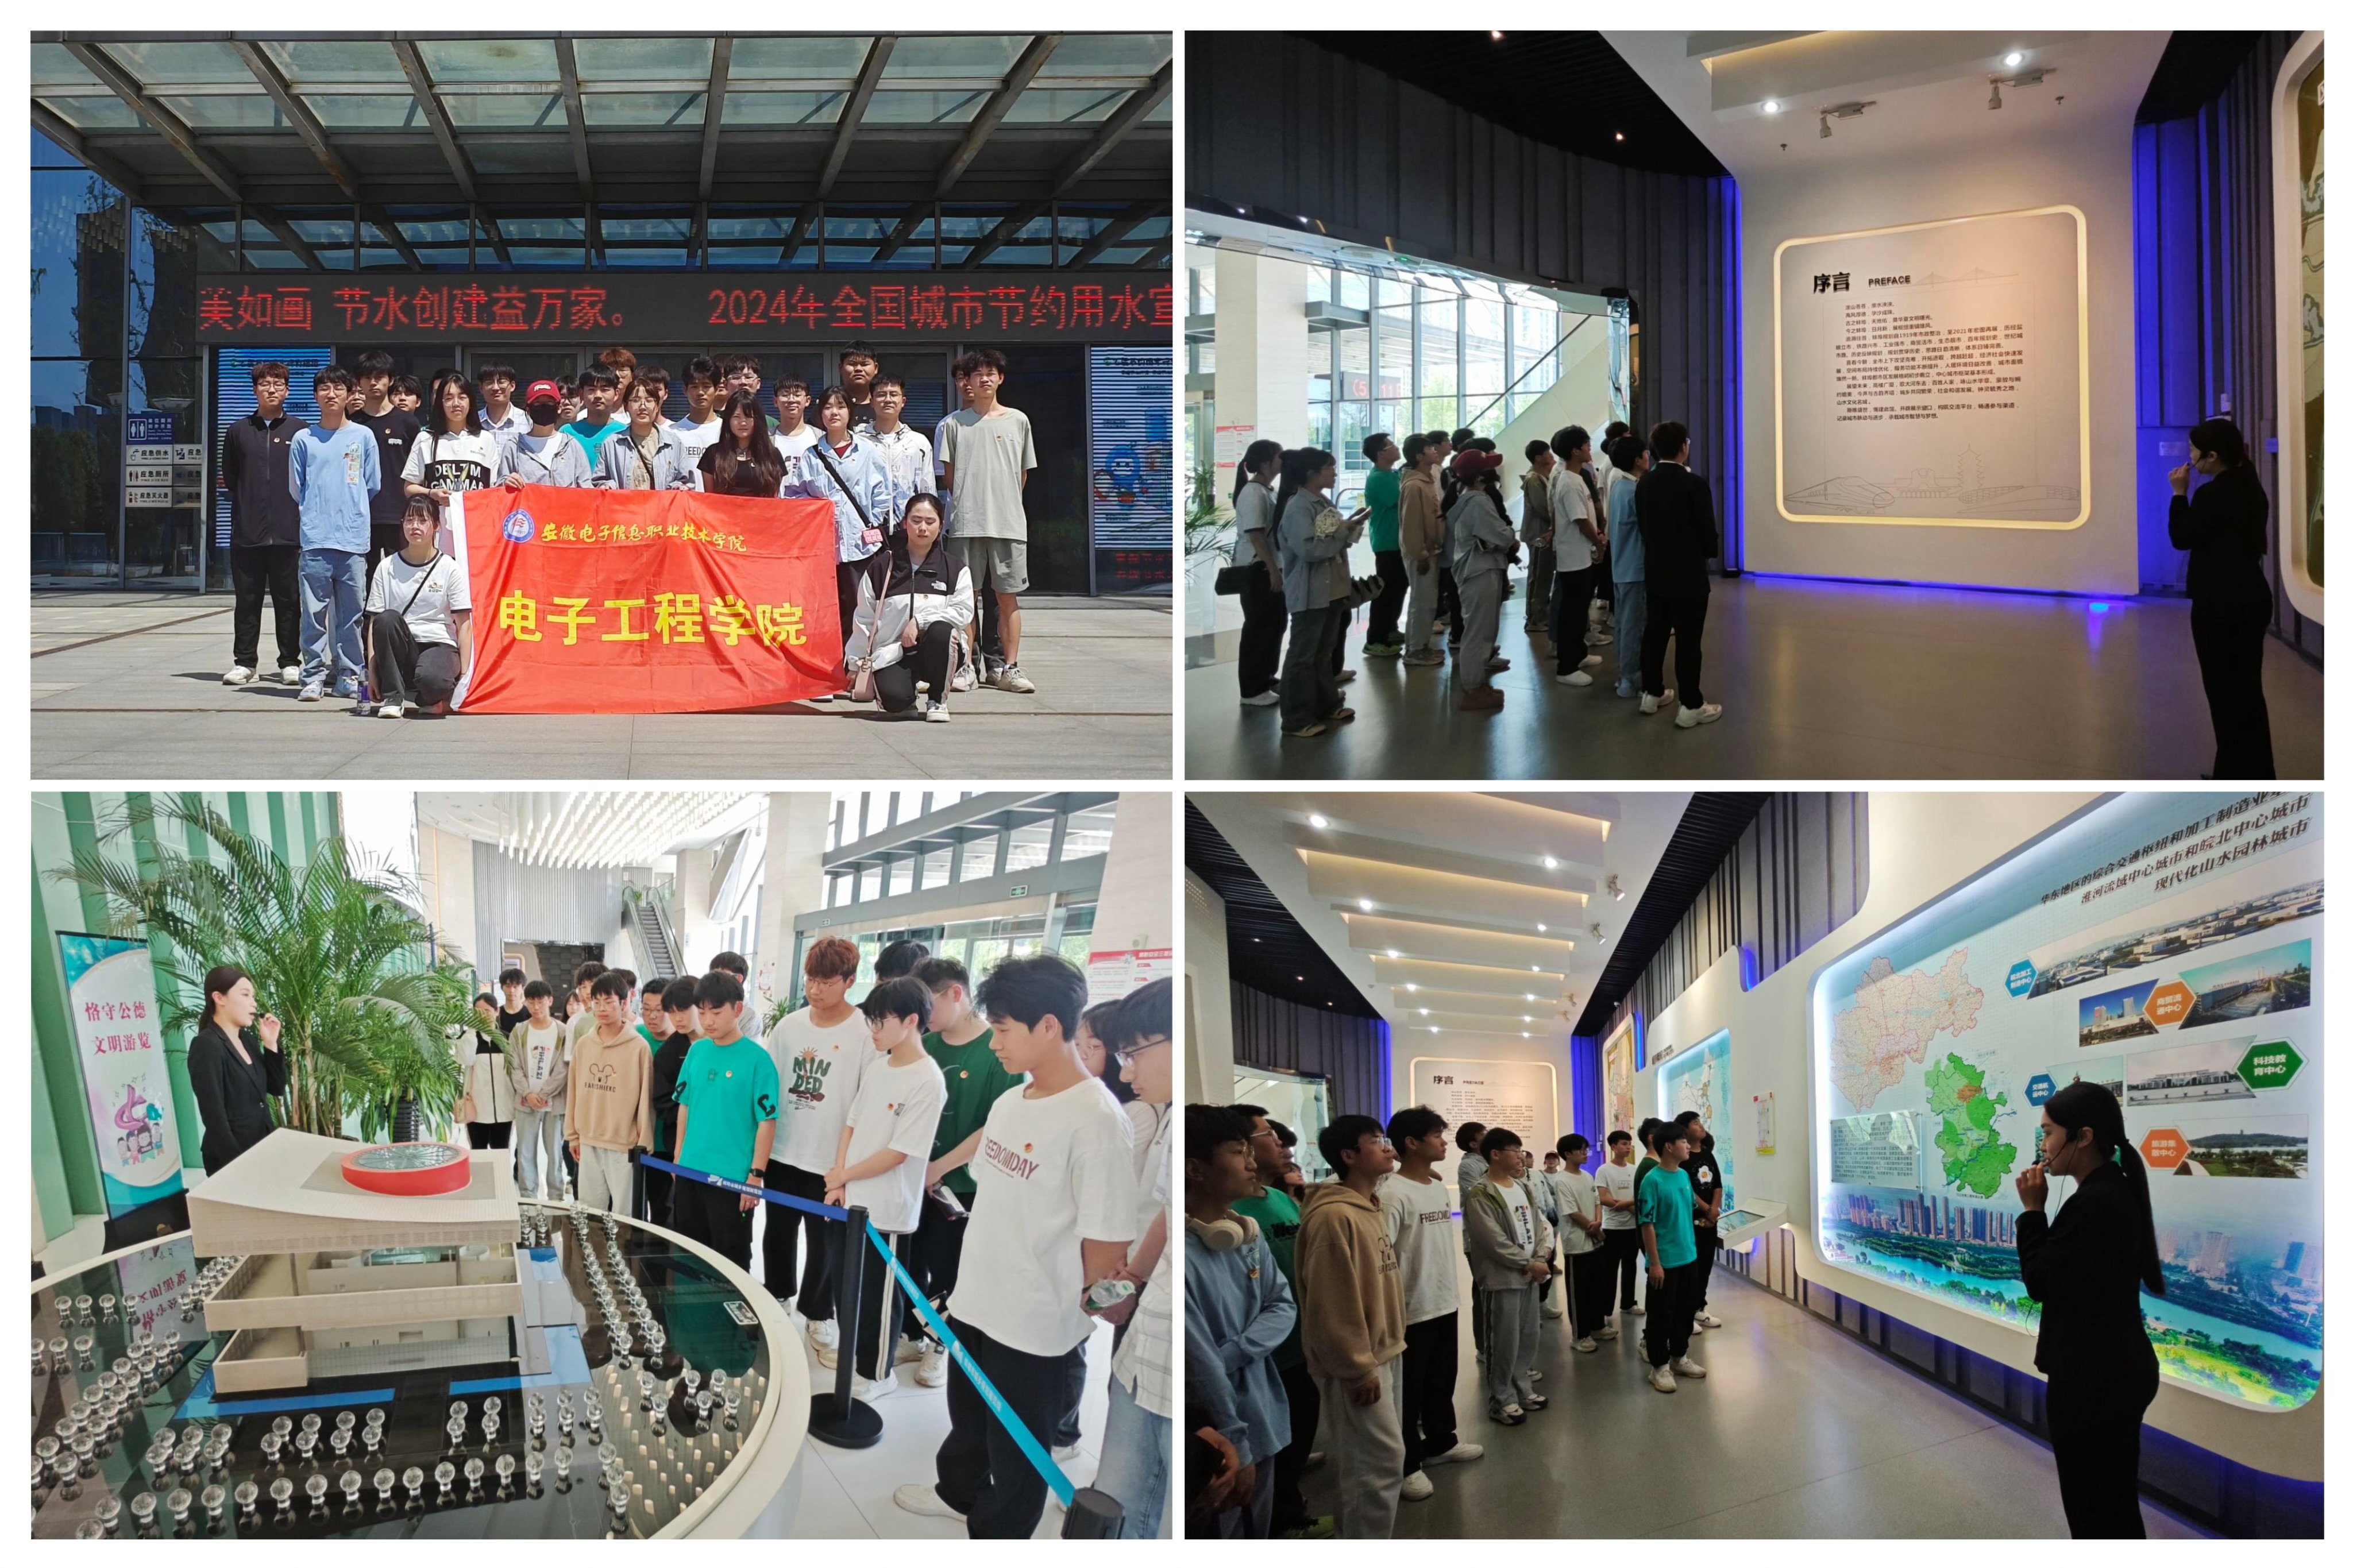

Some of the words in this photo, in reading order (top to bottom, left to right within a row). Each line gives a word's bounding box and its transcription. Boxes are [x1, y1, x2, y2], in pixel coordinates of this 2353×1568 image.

[1813, 272, 1850, 295] 序言
[1868, 275, 1911, 287] PREFACE
[201, 286, 311, 330] 美如画
[335, 285, 623, 330] 节水创建益万家。
[541, 522, 747, 552] 安徽电子信息职业技术学院
[499, 589, 807, 647] 电子工程学院
[2081, 793, 2311, 905] 淮河流域中心城市和皖北中心城市
[2154, 817, 2310, 893] 现代化山水园林城市
[2157, 994, 2182, 1005] 商贸流
[2157, 1004, 2182, 1015] 通中心
[84, 1000, 147, 1022] 恪守公德
[91, 1032, 152, 1056] 文明游览
[793, 1056, 832, 1077] MIN
[2253, 1053, 2286, 1066] 科技教
[2253, 1064, 2286, 1076] 育中心
[792, 1072, 823, 1094] DED
[1433, 1075, 1454, 1085] 序言
[2151, 1140, 2177, 1149] 旅游集
[2151, 1148, 2177, 1157] 散中心
